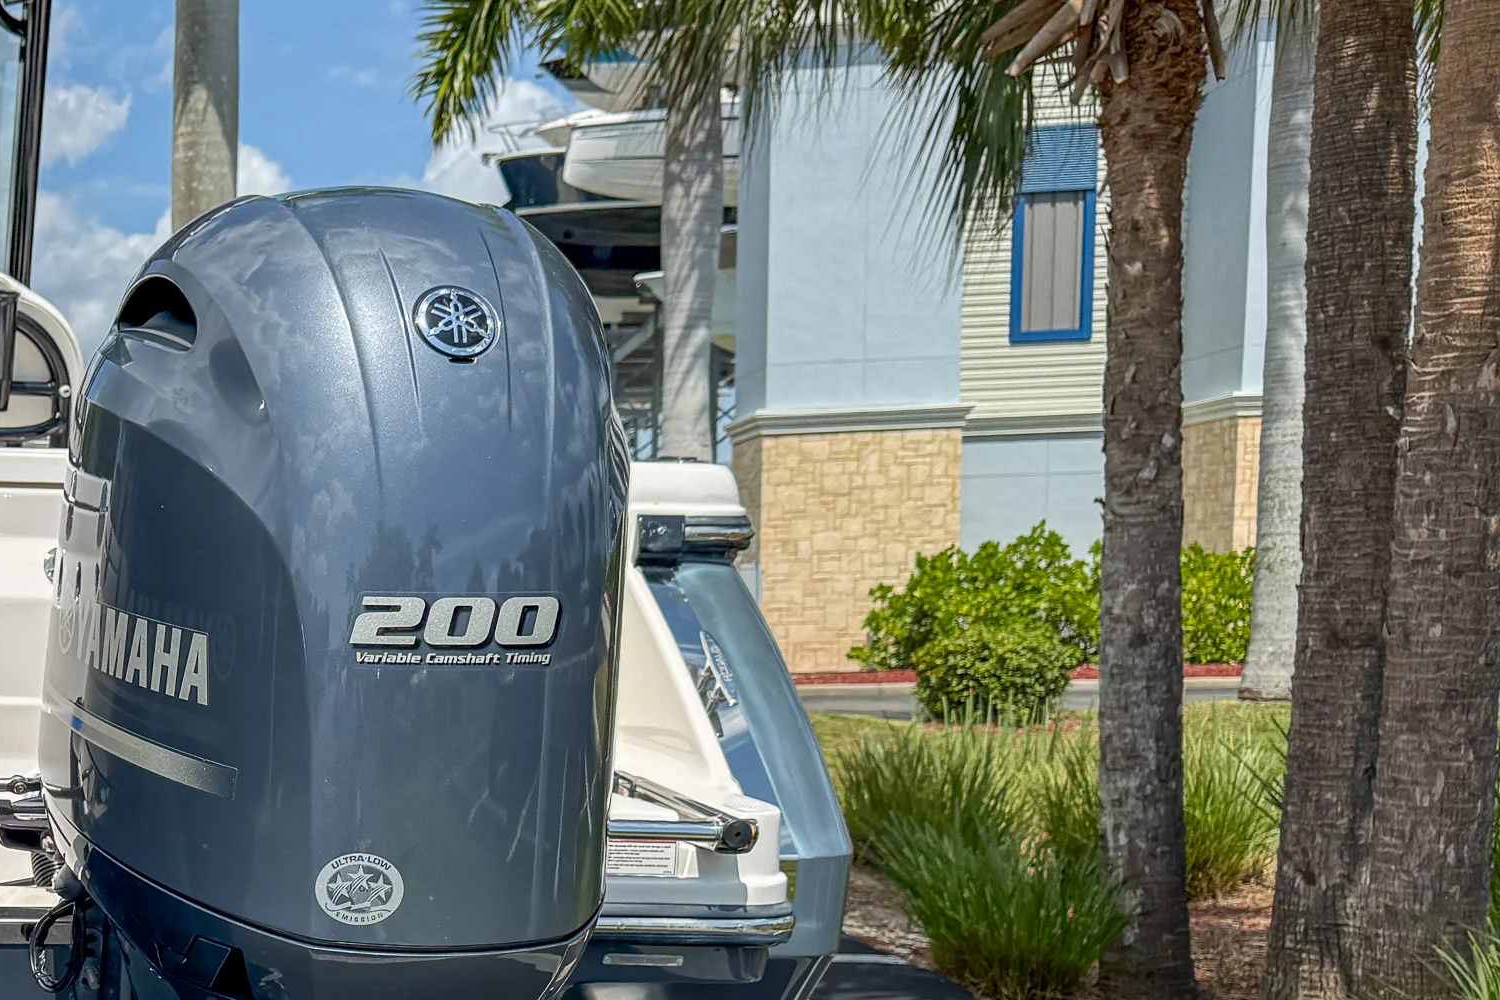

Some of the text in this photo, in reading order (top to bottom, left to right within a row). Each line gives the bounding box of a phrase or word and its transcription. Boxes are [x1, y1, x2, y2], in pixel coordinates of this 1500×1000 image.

[349, 596, 561, 646] 200
[76, 600, 209, 706] YAMAHA
[355, 651, 551, 666] Variable Camshaft Timing
[335, 911, 384, 923] EMISSION
